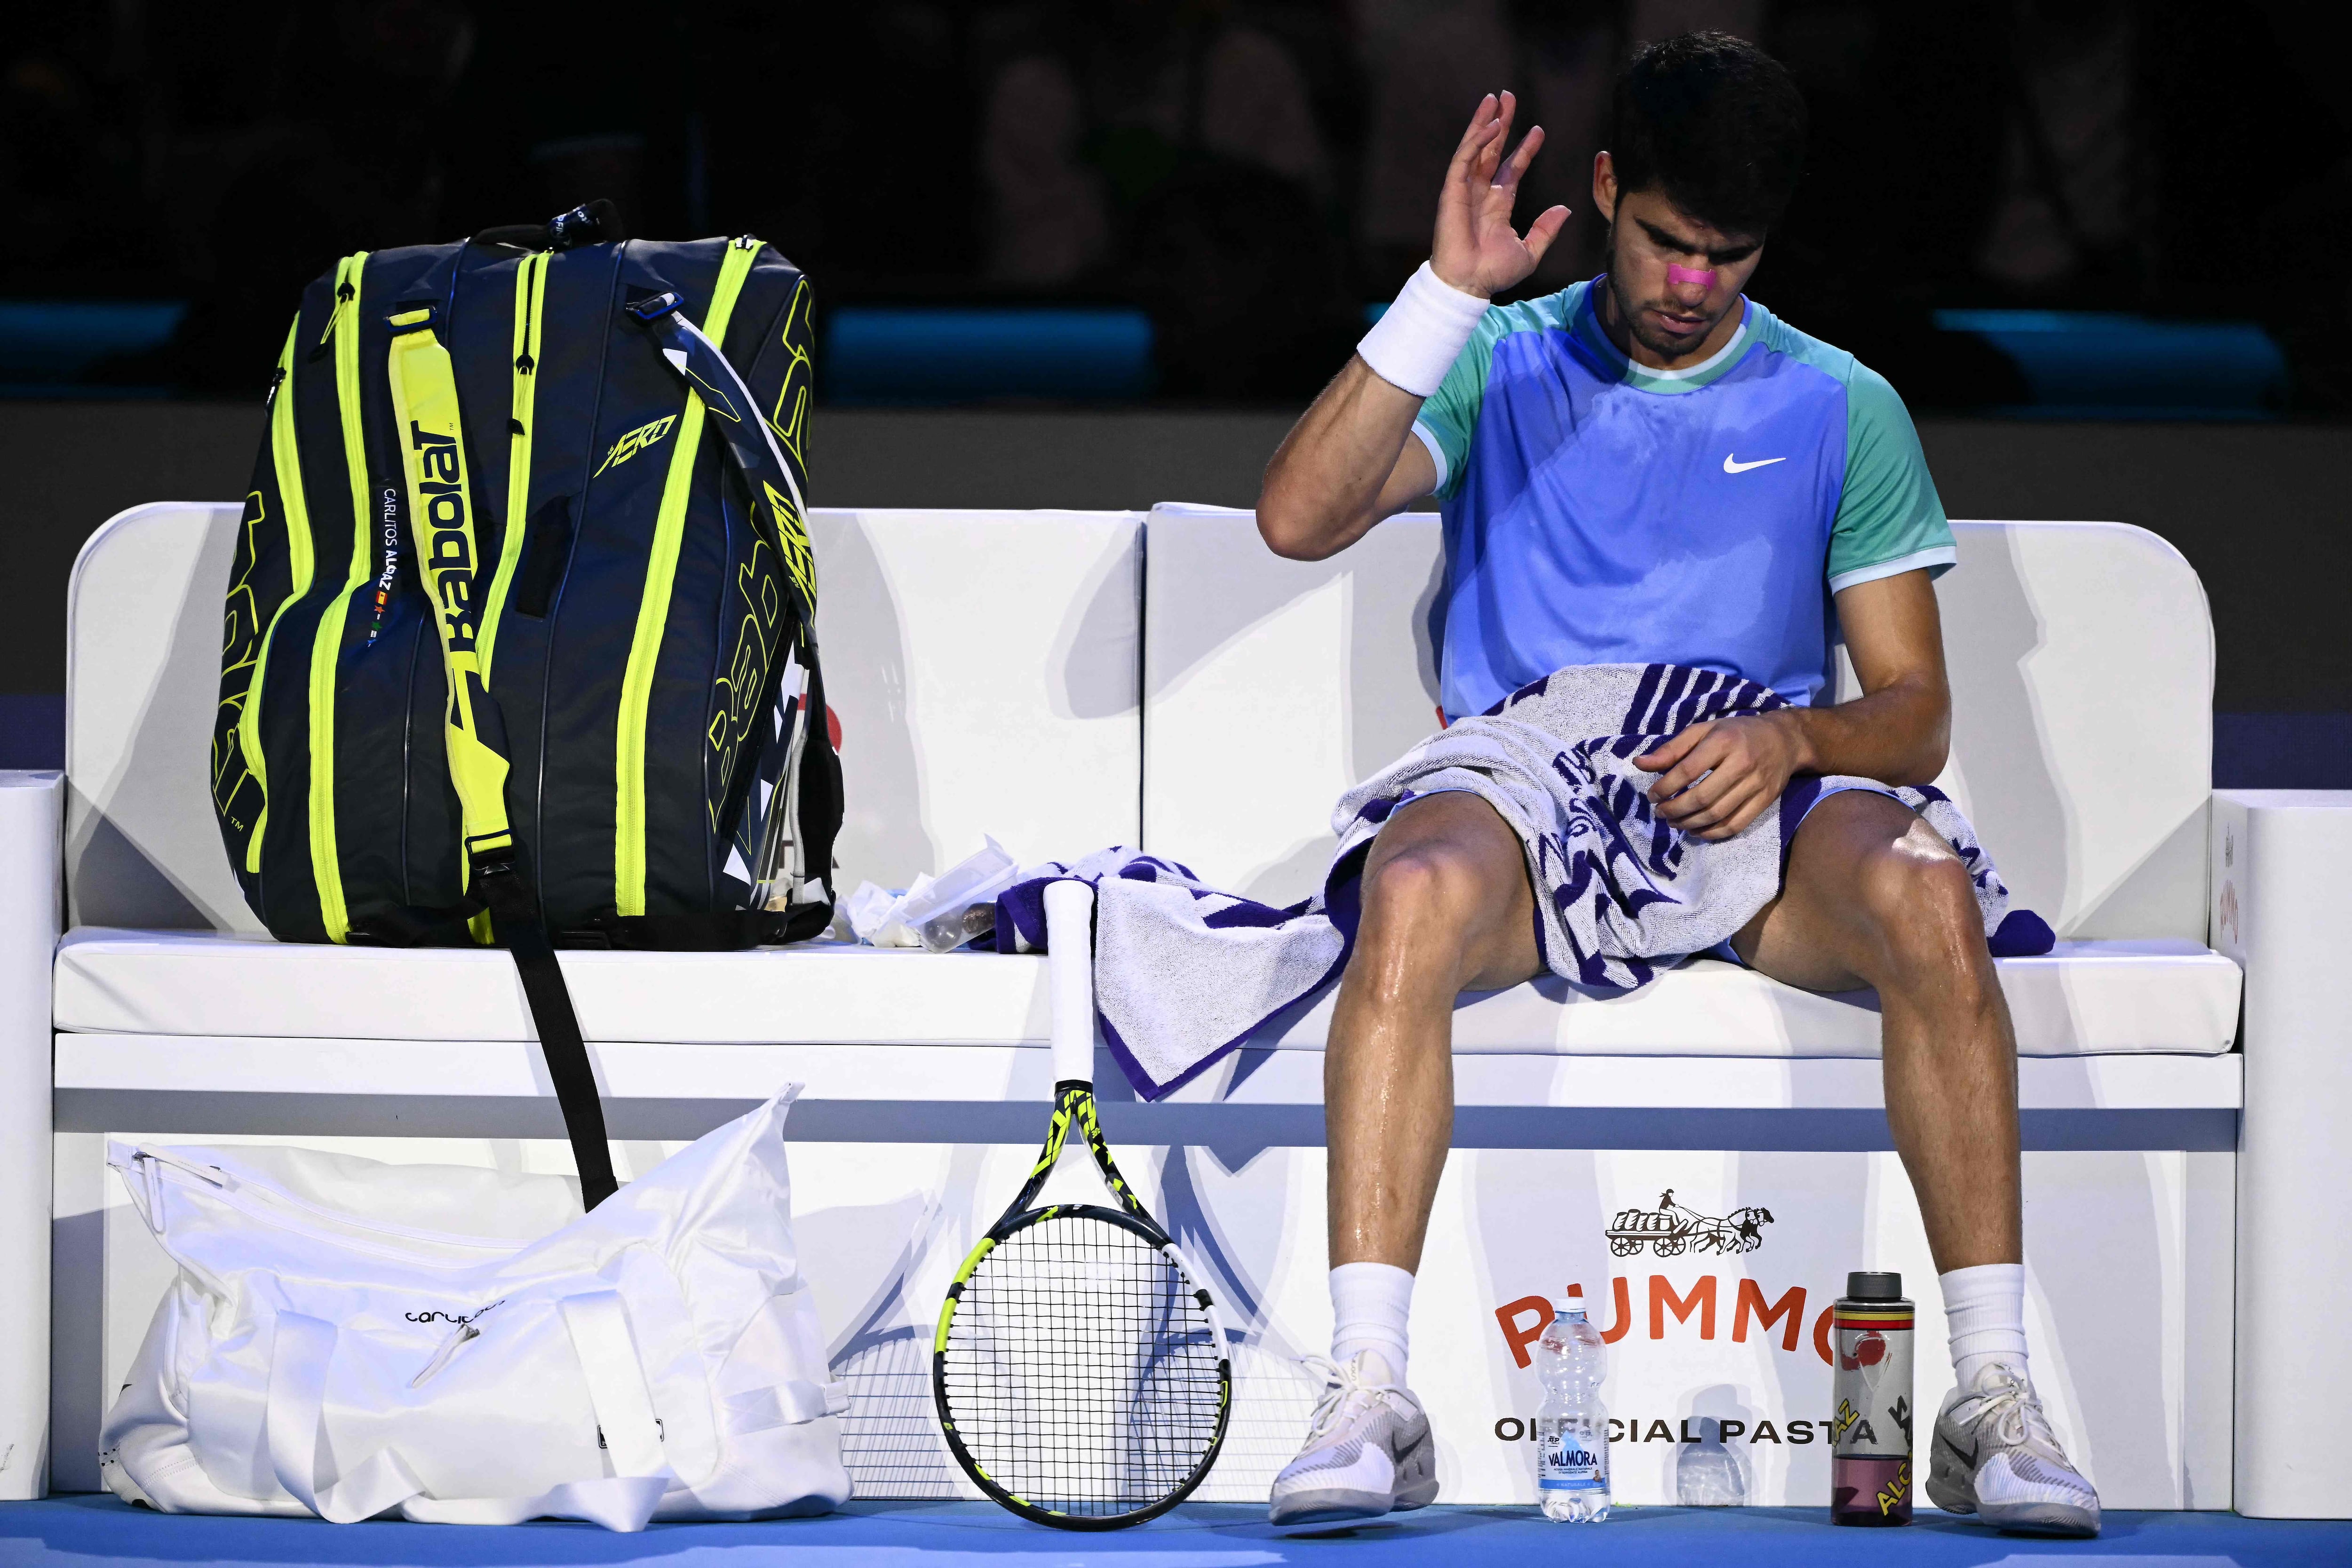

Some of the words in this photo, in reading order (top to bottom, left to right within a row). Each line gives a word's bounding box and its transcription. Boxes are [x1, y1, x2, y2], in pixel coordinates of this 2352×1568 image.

[593, 414, 677, 479] AERO
[384, 488, 398, 546] CARLITOS
[230, 816, 244, 832] TM
[1549, 1450, 1598, 1466] VALMORA
[1876, 1450, 1913, 1517] ALC
